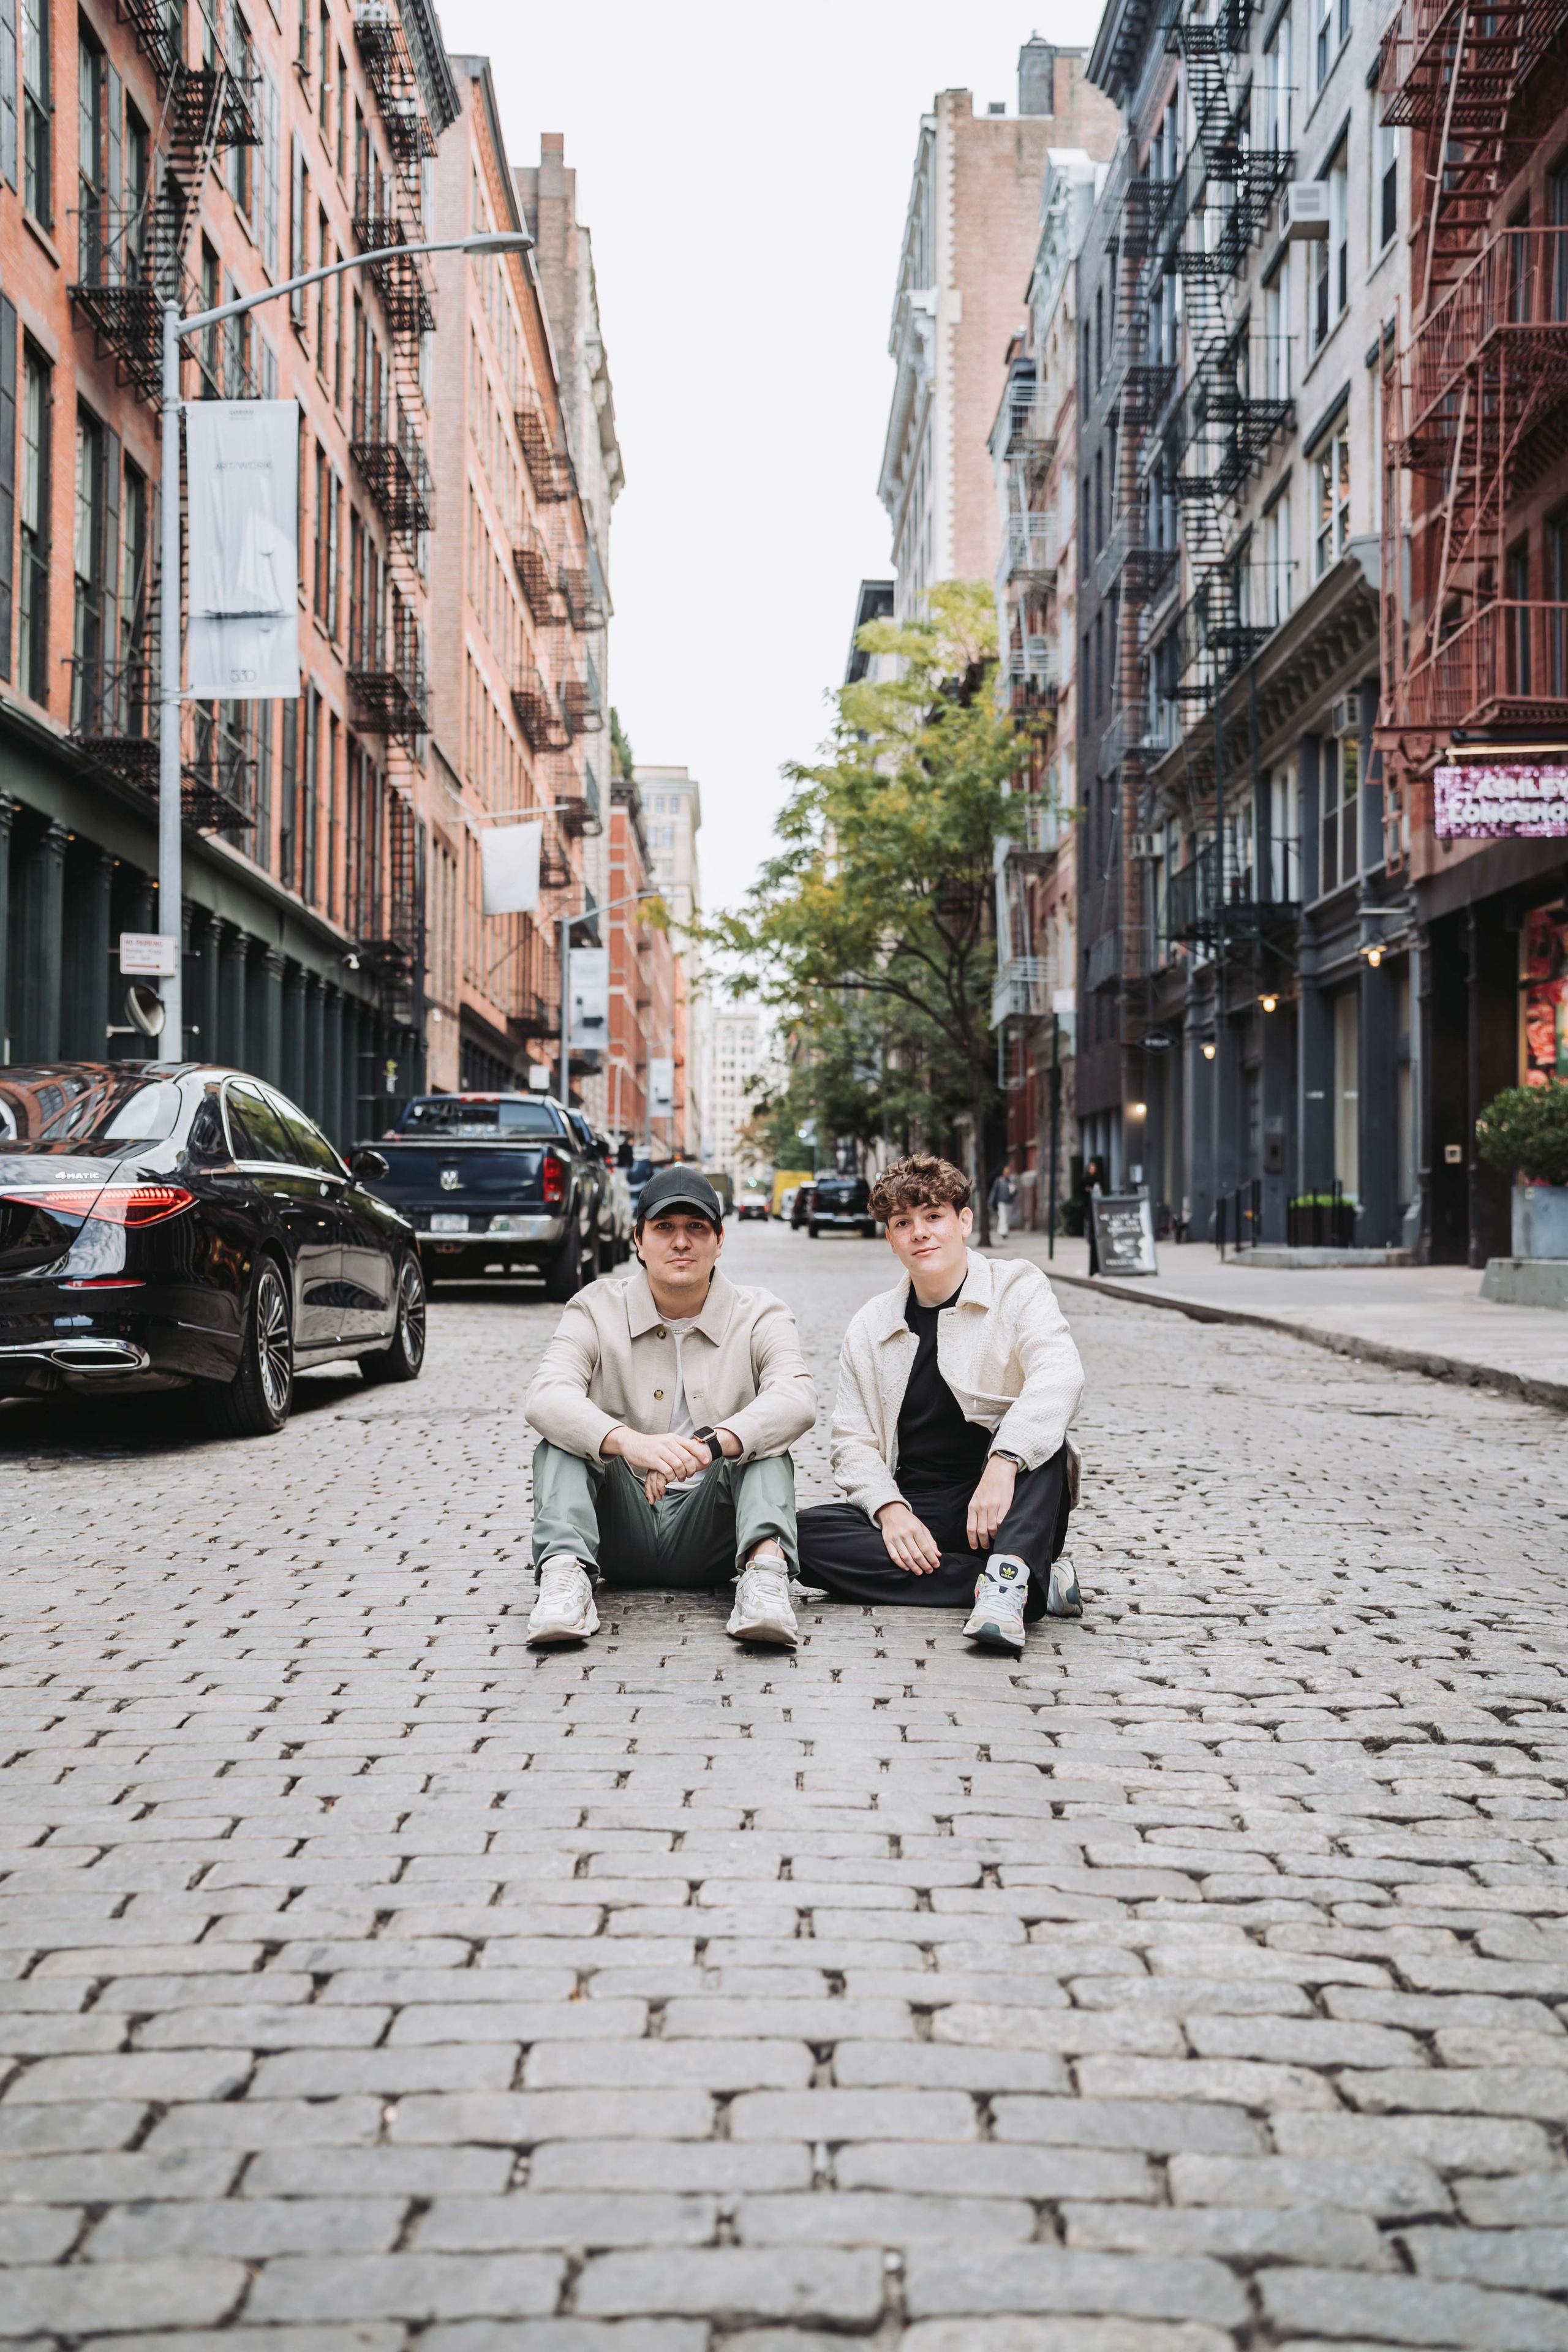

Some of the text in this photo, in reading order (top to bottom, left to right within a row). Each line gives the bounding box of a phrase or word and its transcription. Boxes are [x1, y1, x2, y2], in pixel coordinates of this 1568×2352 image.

[1474, 777, 1568, 798] ASHLEY
[1449, 801, 1568, 824] LONGSHO
[55, 1171, 100, 1180] 4MATIC
